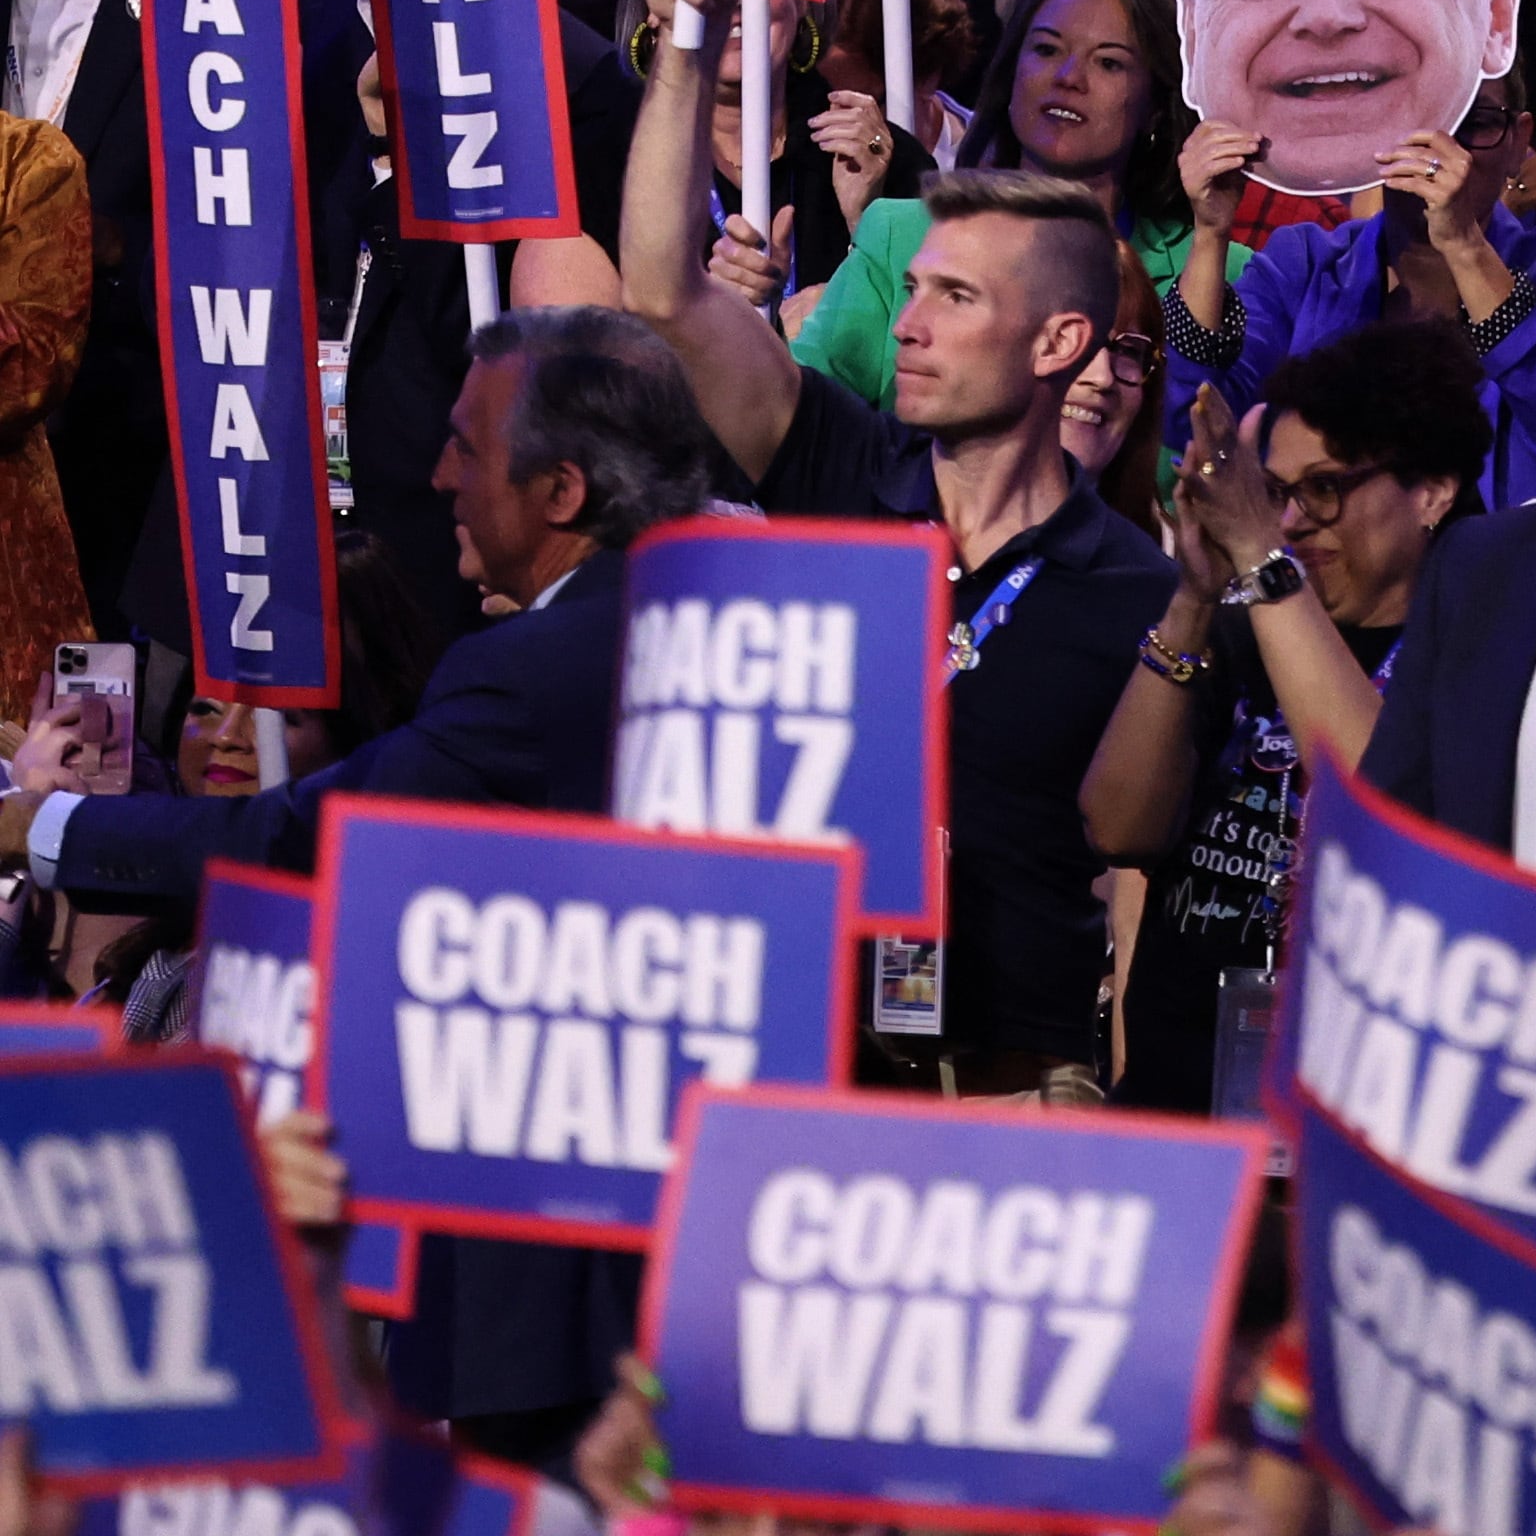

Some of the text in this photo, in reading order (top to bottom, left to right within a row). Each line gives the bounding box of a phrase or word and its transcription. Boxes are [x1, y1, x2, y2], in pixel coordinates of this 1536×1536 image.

[189, 284, 273, 652] WALZ
[398, 886, 764, 1032] COACH
[747, 1165, 1155, 1309] COACH
[737, 1281, 1131, 1461] WALZ
